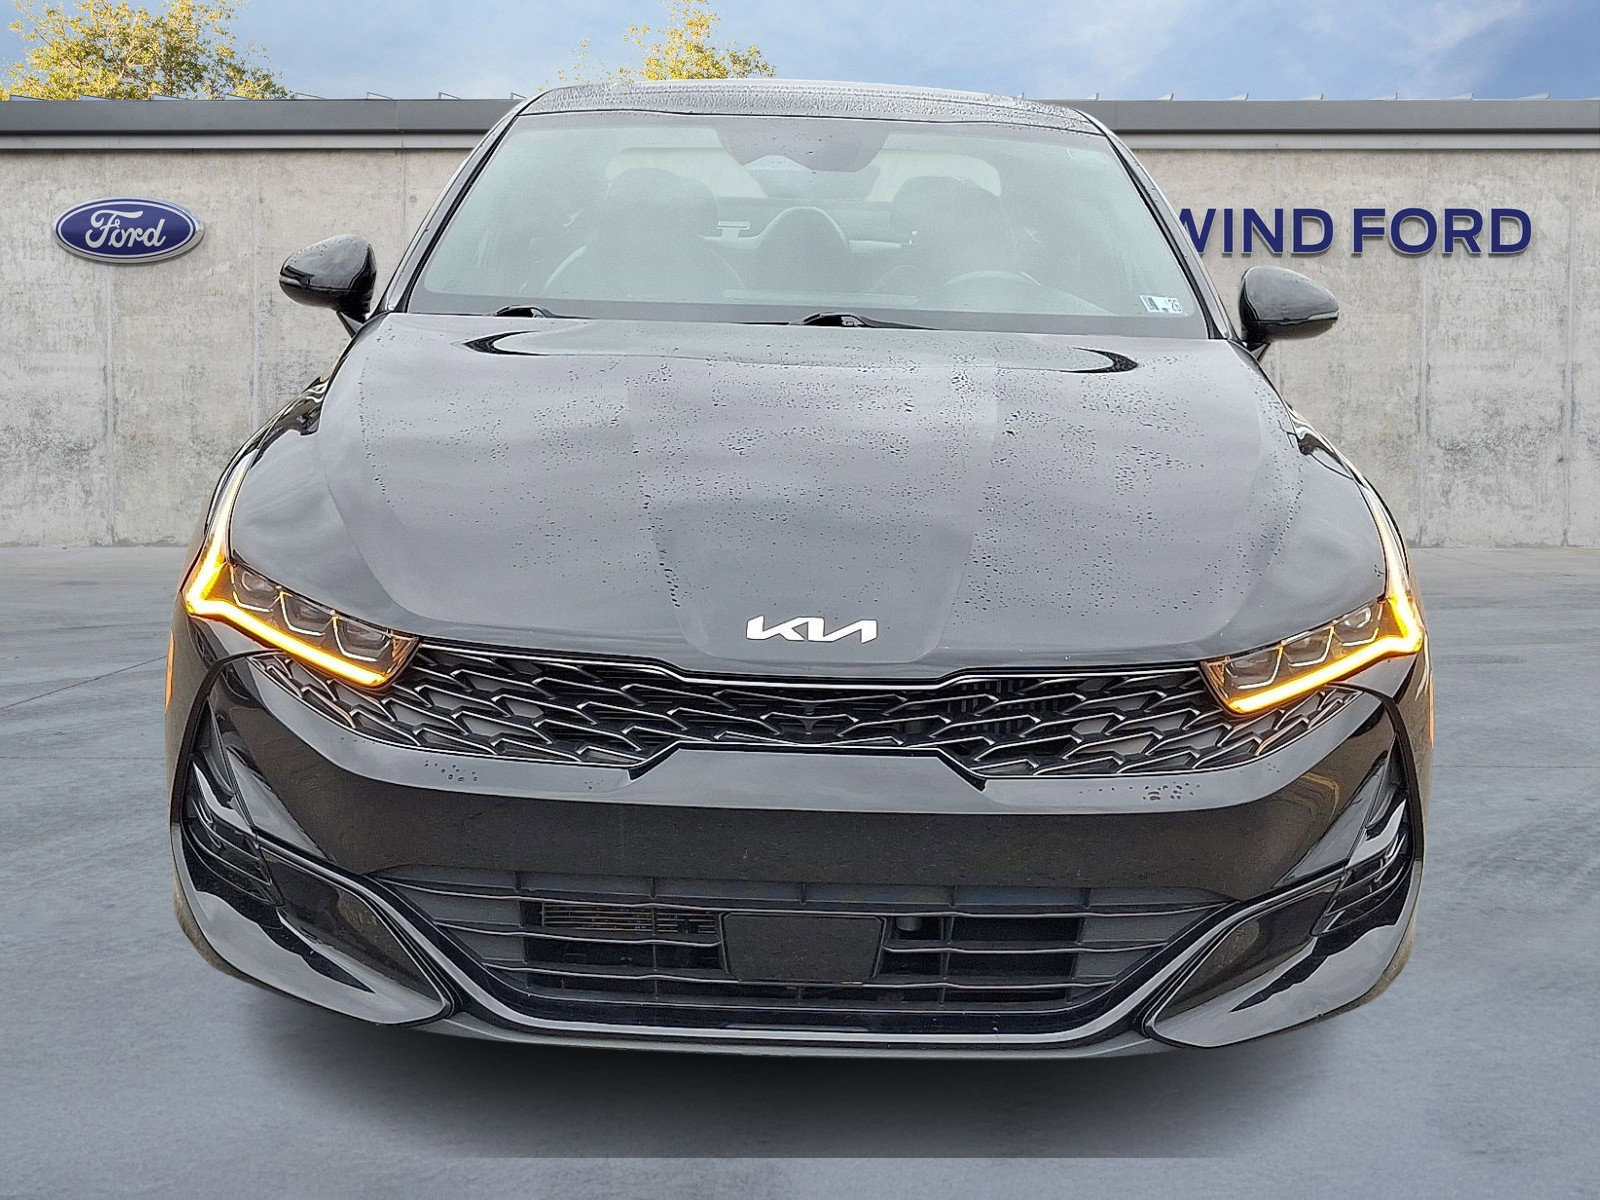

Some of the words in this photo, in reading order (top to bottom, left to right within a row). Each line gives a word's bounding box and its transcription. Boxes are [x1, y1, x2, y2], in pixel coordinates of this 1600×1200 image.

[85, 209, 166, 248] Ford
[1353, 207, 1532, 253] FORD
[746, 613, 878, 644] KIA
